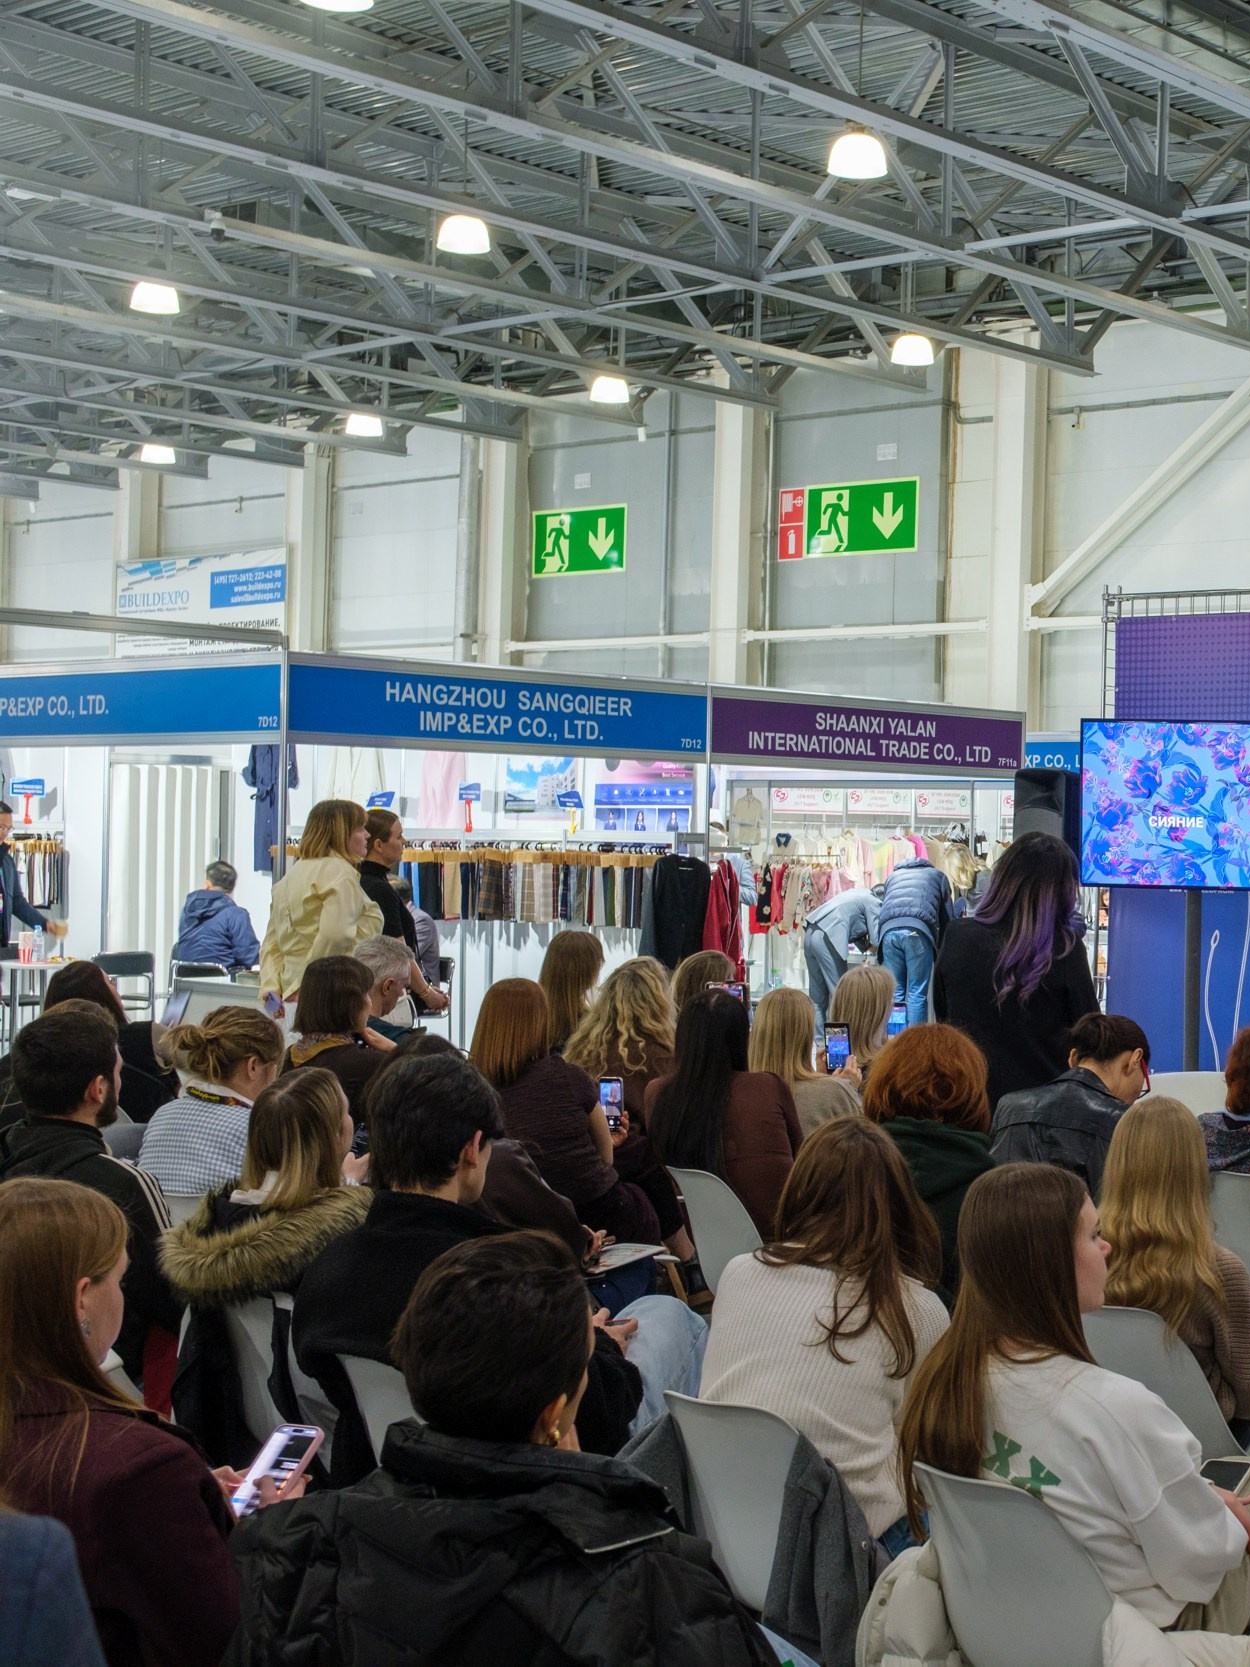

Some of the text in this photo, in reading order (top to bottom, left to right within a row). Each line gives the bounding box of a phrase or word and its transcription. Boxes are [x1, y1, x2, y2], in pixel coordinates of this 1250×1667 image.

[127, 590, 190, 608] BUILDEXPO
[47, 696, 75, 719] CO.,
[79, 694, 109, 715] LTD.
[385, 681, 633, 717] HANGZHOU SANGQIEER
[257, 716, 278, 728] 7D12
[419, 711, 604, 742] IMP&EXP CO., LTD.
[815, 712, 936, 738] SHAANXI YALAN
[680, 738, 702, 749] 7D12
[748, 731, 992, 764] INTERNATIONAL TRADE CO., LTD
[998, 757, 1017, 768] 7F11a
[1044, 755, 1072, 770] CO.,
[1148, 815, 1204, 829] СИЯНИЕ
